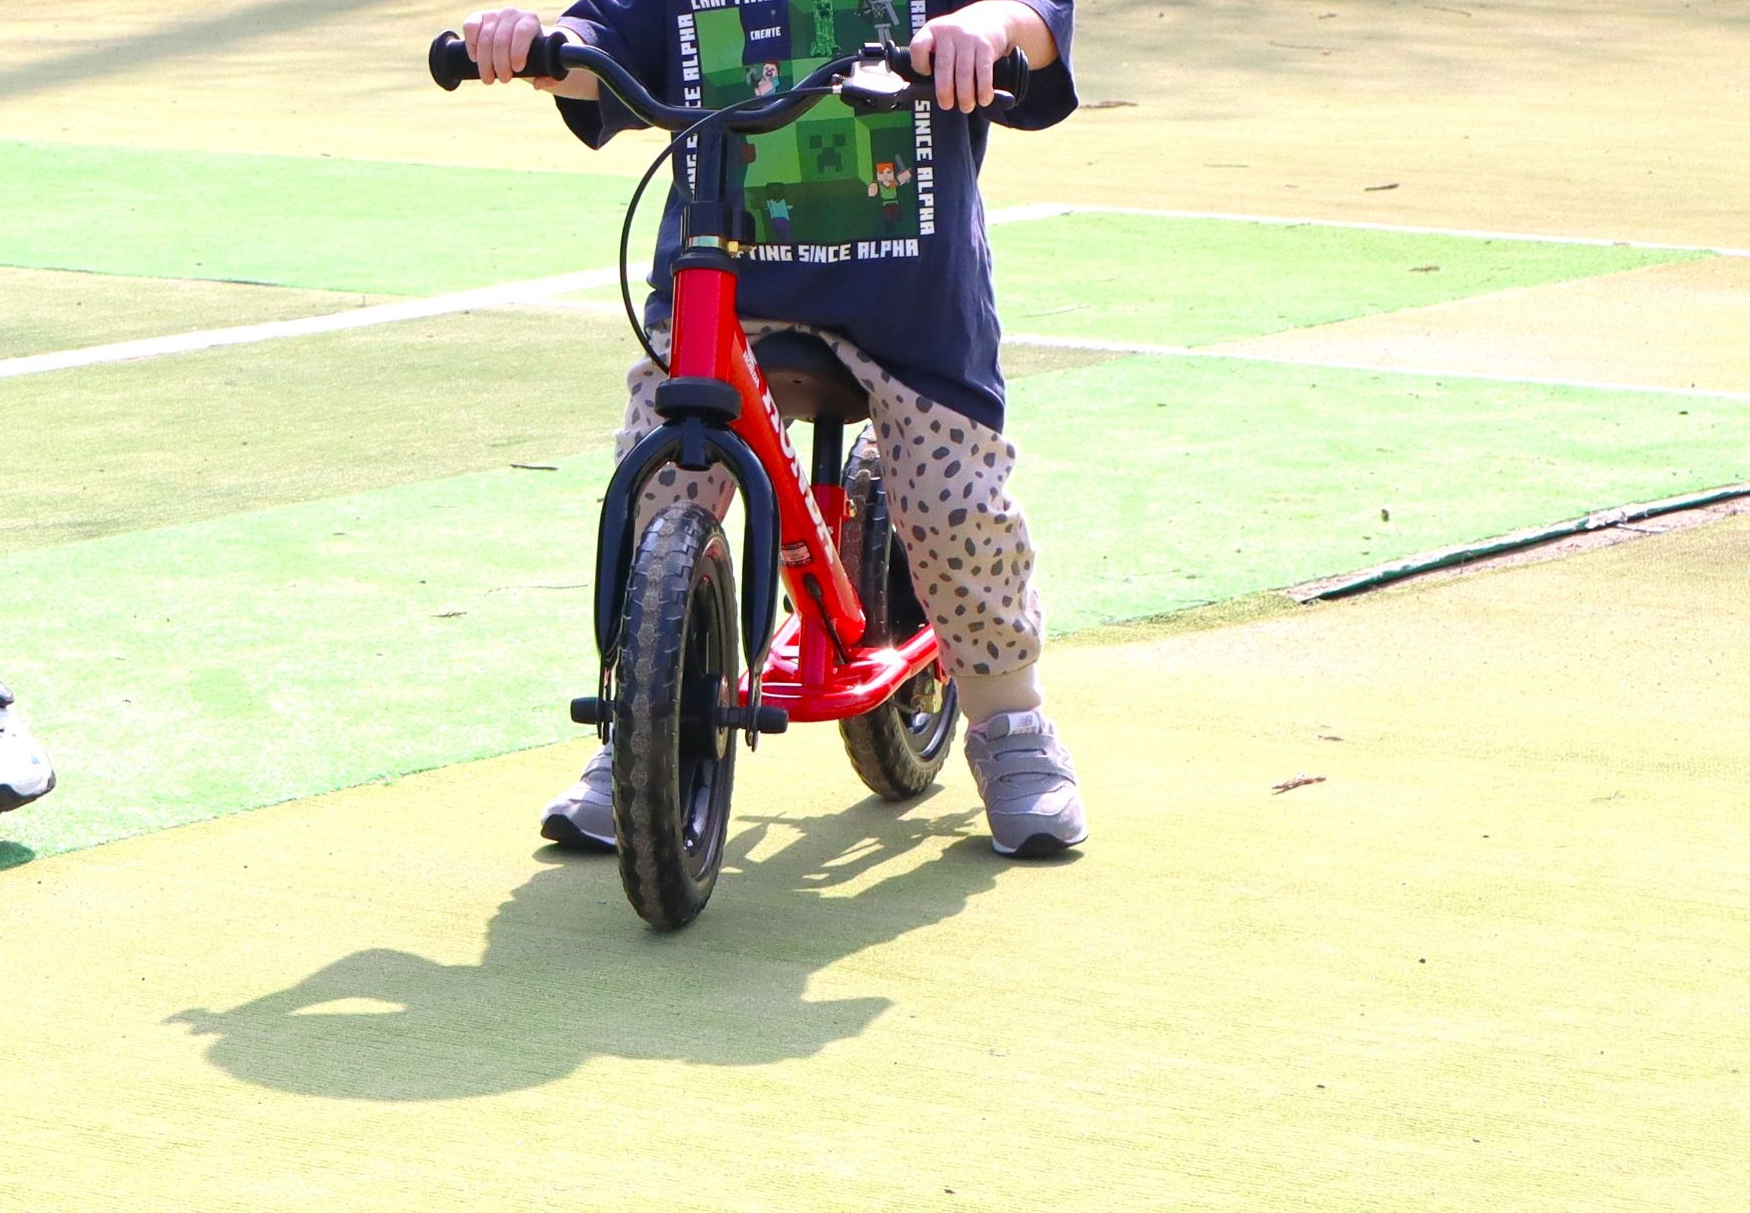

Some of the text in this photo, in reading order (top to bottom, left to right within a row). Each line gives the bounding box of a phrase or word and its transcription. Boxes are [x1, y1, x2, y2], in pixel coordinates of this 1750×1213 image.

[677, 12, 701, 82] ALPHA
[750, 26, 782, 42] CREATE
[914, 99, 936, 236] SINCE ALPHA
[797, 243, 852, 264] SINCE
[857, 238, 919, 260] ALPHA
